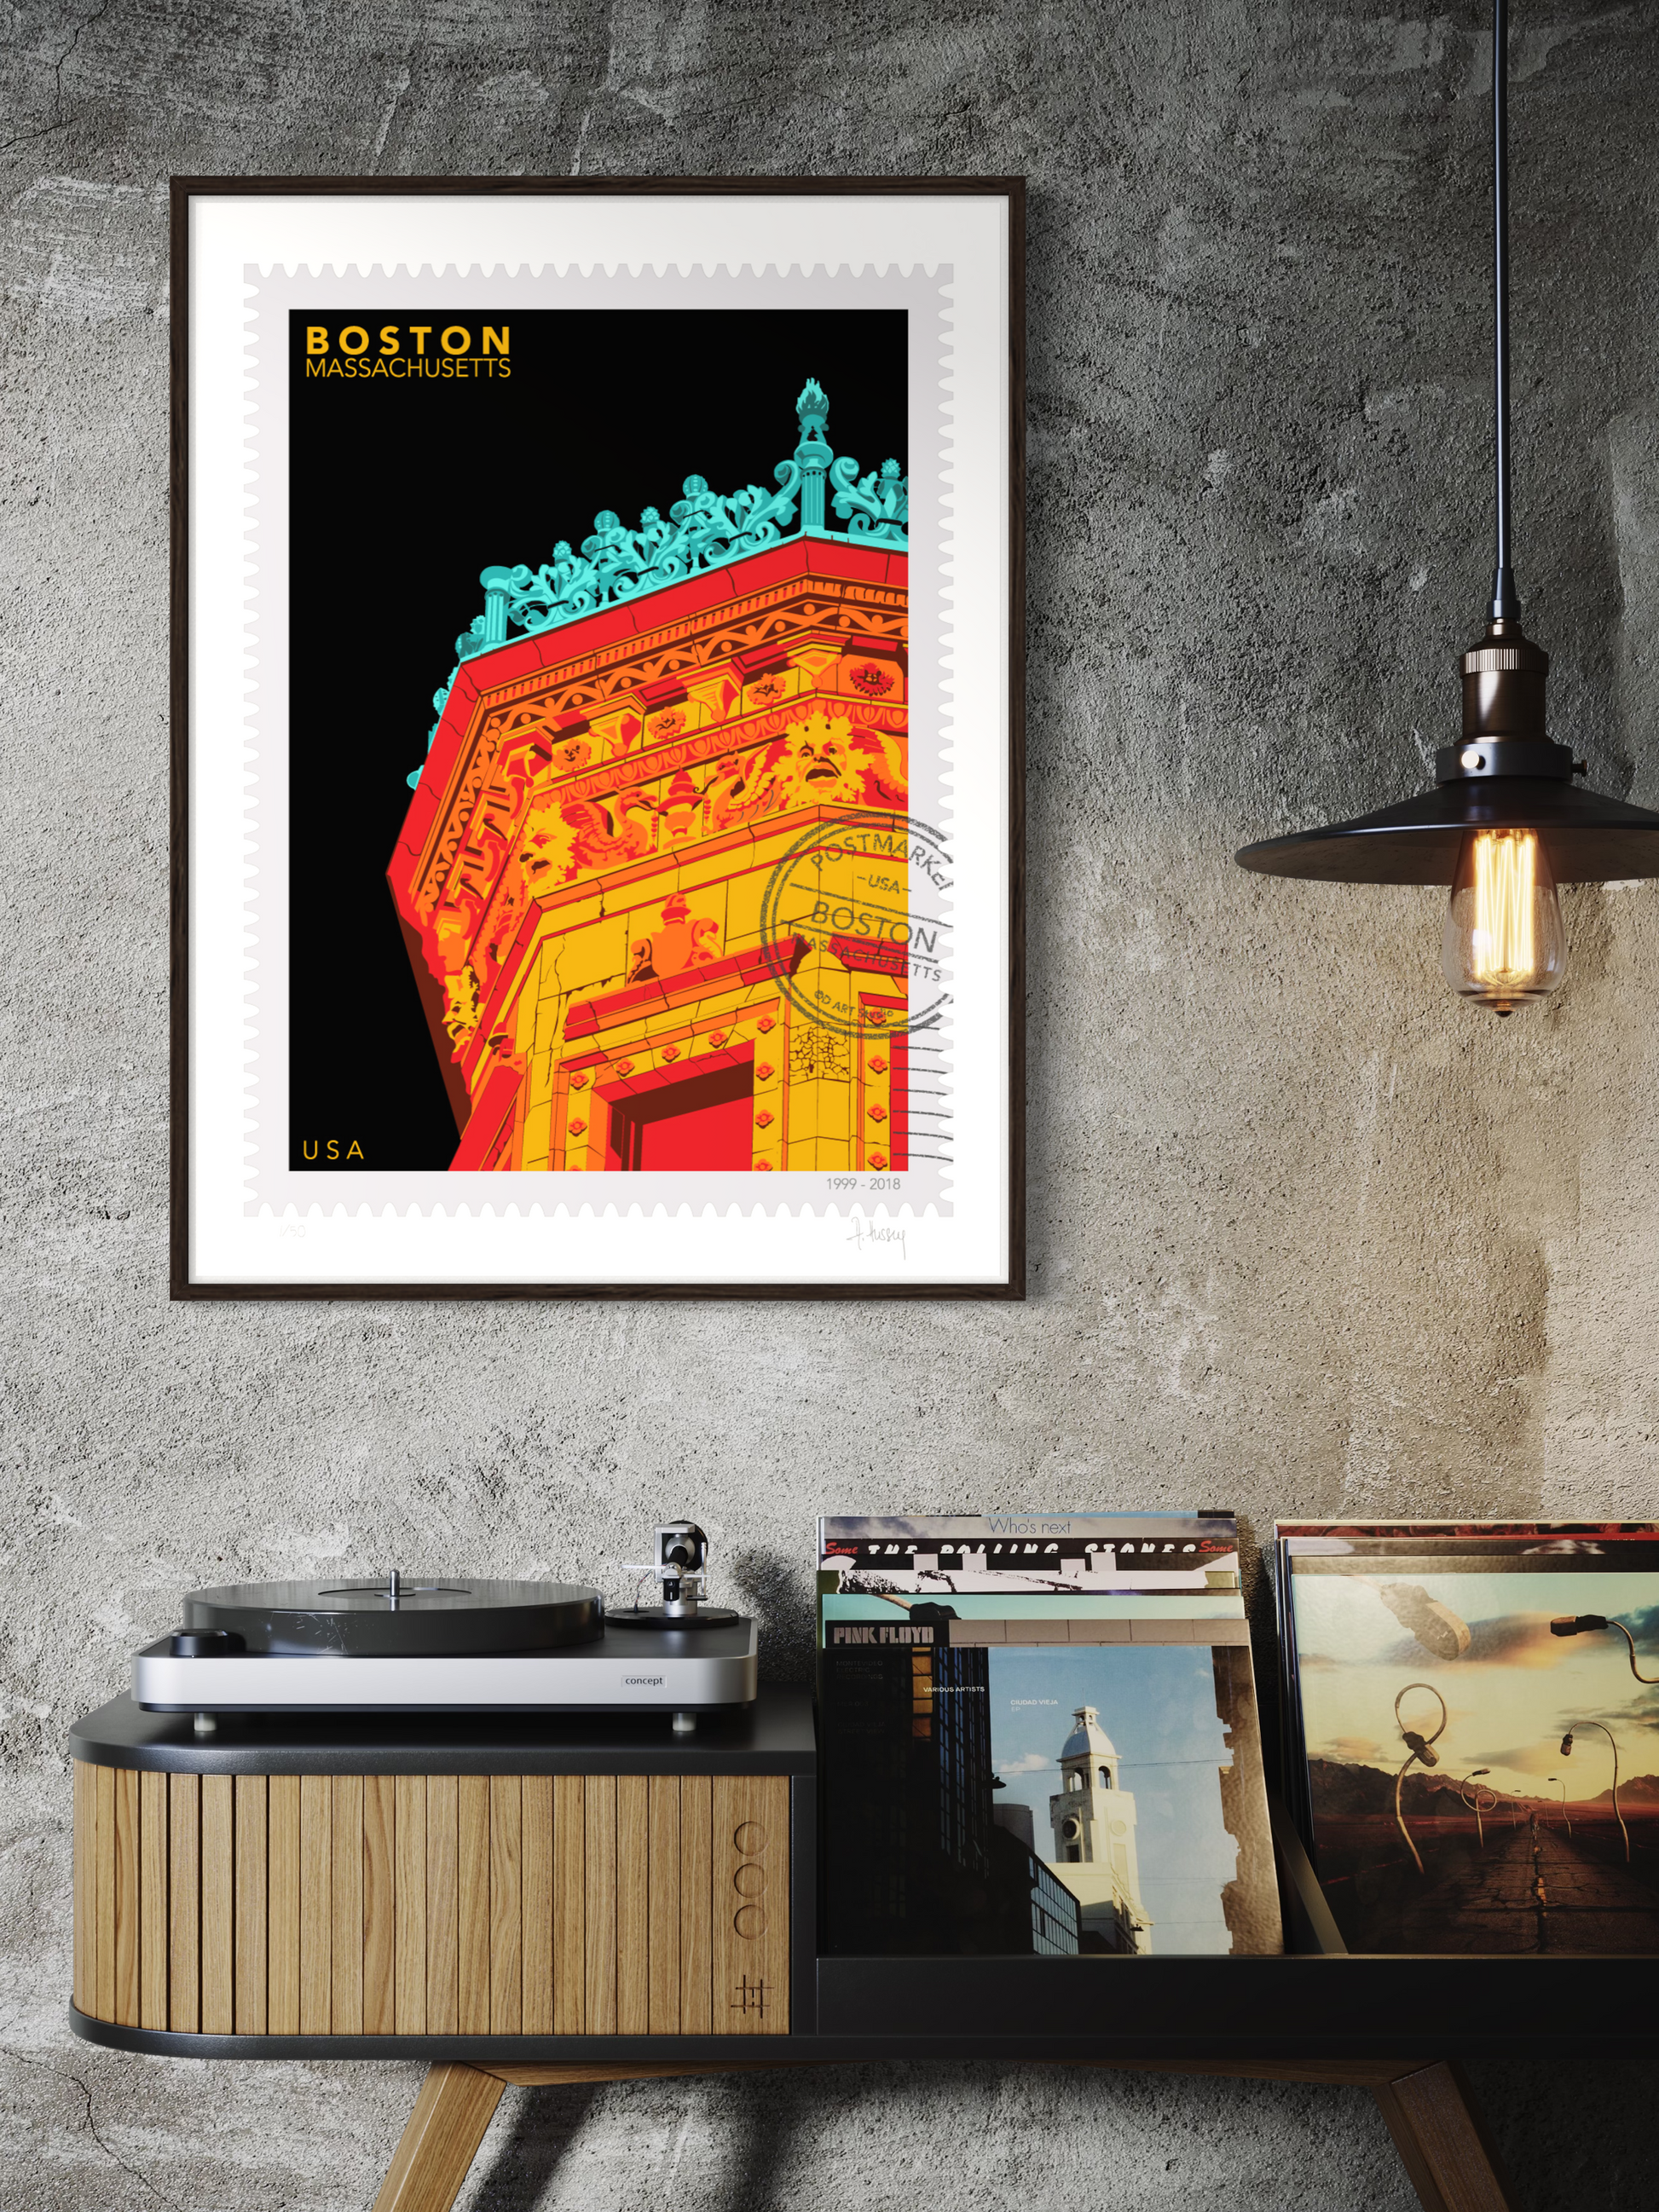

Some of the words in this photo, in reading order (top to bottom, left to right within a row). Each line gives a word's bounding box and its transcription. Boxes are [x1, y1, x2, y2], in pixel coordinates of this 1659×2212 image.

[306, 326, 510, 355] BOSTON
[306, 357, 512, 378] MASSACHUSETTS
[810, 900, 938, 953] BOSTON
[790, 932, 943, 982] MASSACHUSETTS
[831, 1002, 856, 1017] ART
[303, 1139, 364, 1160] USA
[826, 1177, 858, 1190] 1999
[869, 1177, 901, 1190] 2018
[988, 1517, 1037, 1534] Who's
[1041, 1522, 1072, 1534] next
[824, 1541, 858, 1555] Some
[1198, 1539, 1234, 1553] Some
[833, 1626, 877, 1644] PINK
[879, 1626, 934, 1644] FLOYD
[625, 1677, 663, 1686] concept
